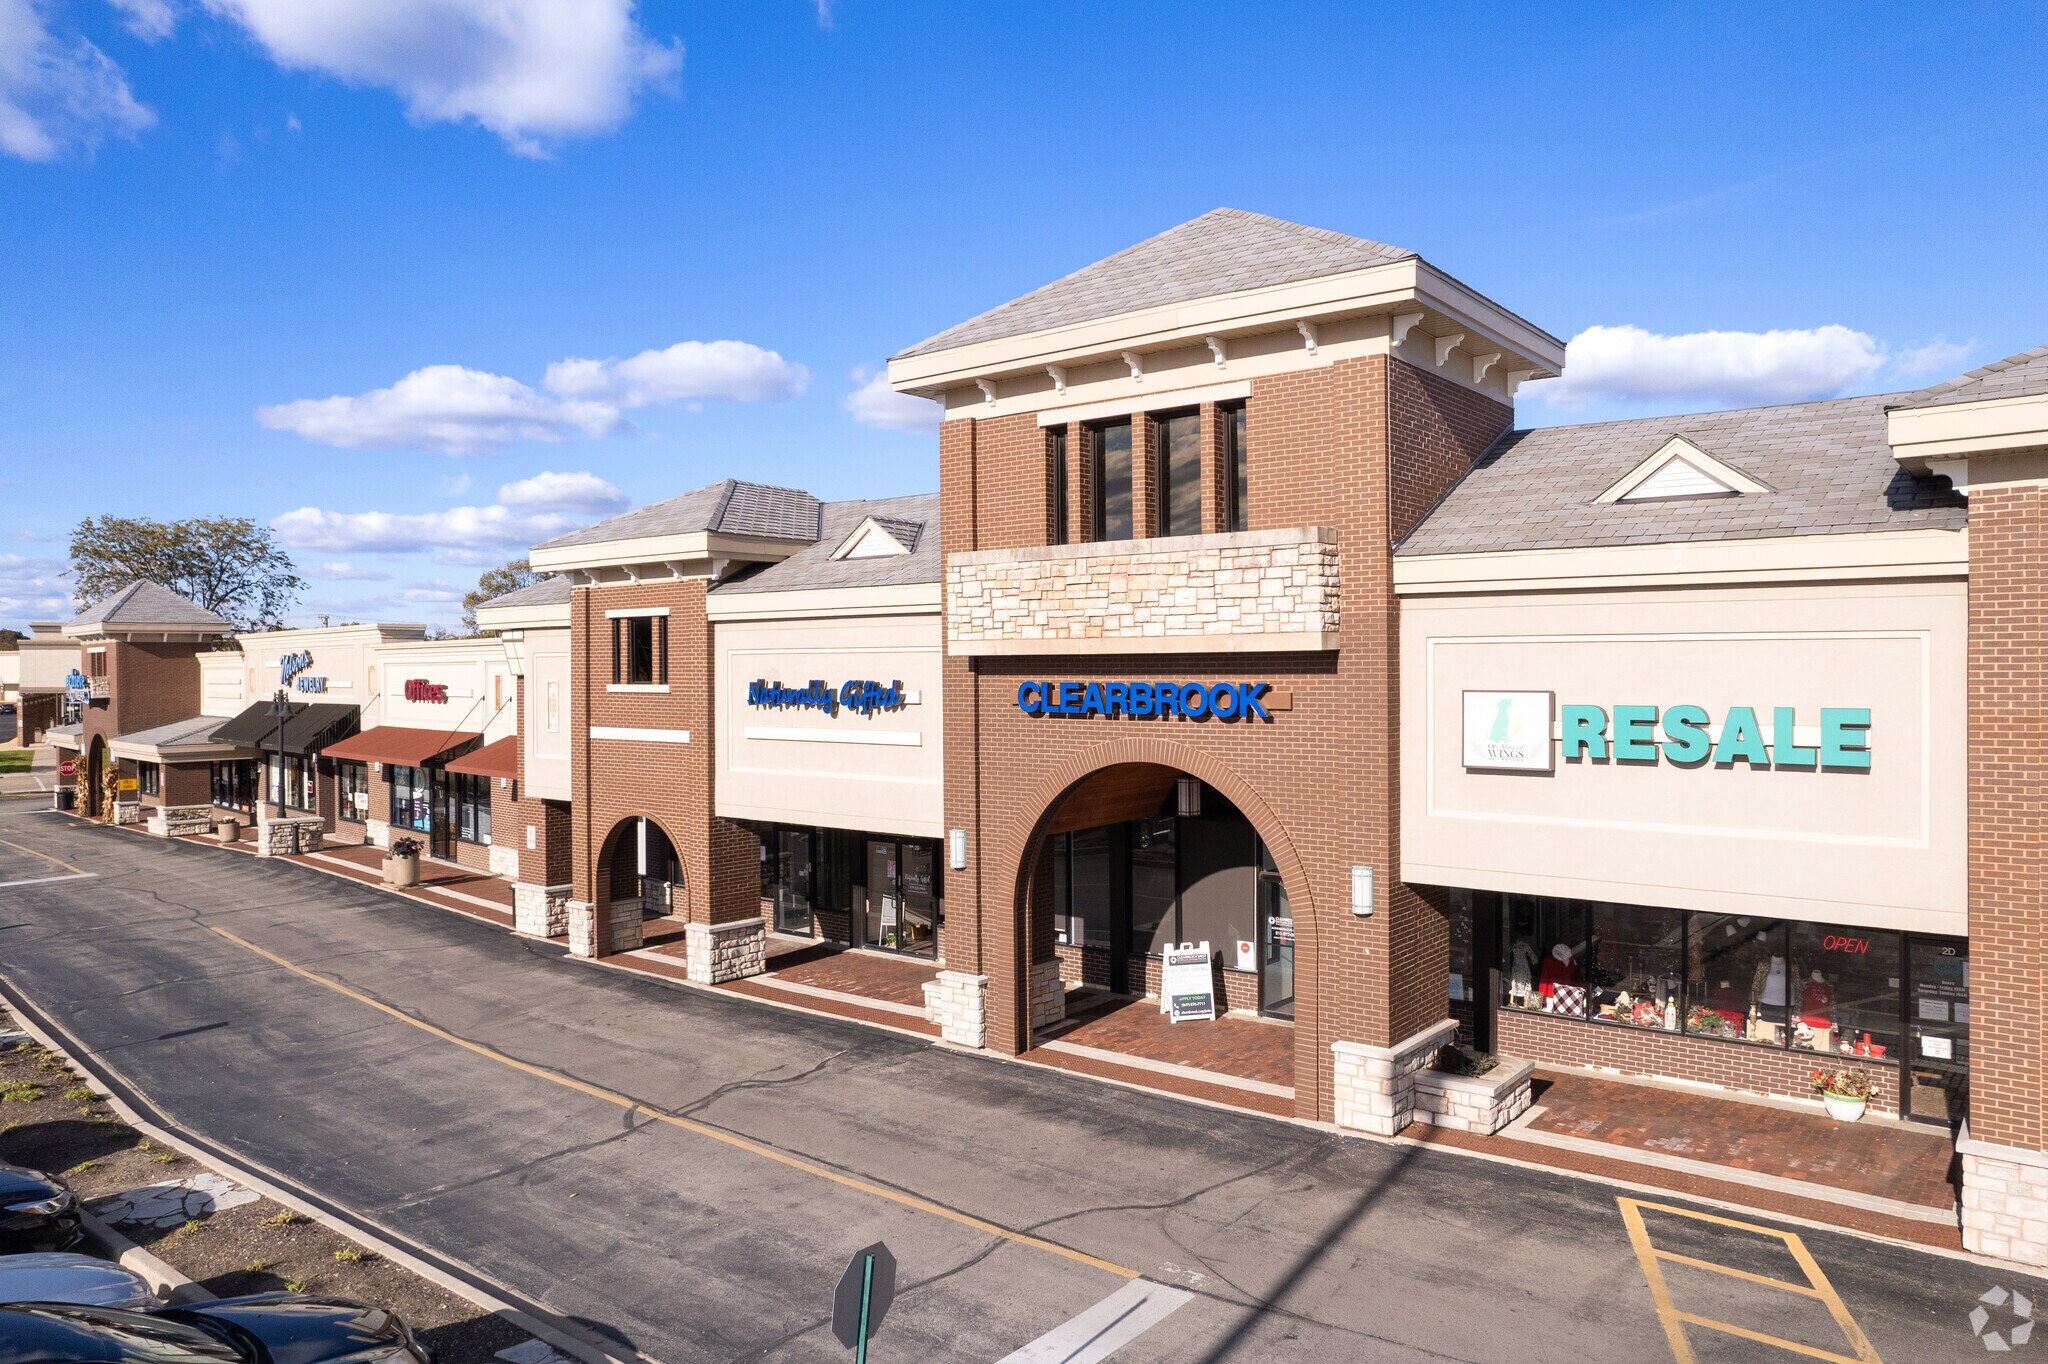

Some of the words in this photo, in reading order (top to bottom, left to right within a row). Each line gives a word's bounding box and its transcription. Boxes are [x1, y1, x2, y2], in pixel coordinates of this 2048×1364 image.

[297, 676, 325, 693] JEWELRY
[404, 679, 443, 702] Offices
[748, 678, 833, 714] Naturally
[839, 679, 901, 716] Gifted
[1017, 681, 1269, 718] CLEARBROOK
[1561, 704, 1871, 768] RESALE
[1487, 749, 1525, 758] WINGS
[1823, 935, 1869, 954] OPEN
[1942, 947, 1956, 956] 2D
